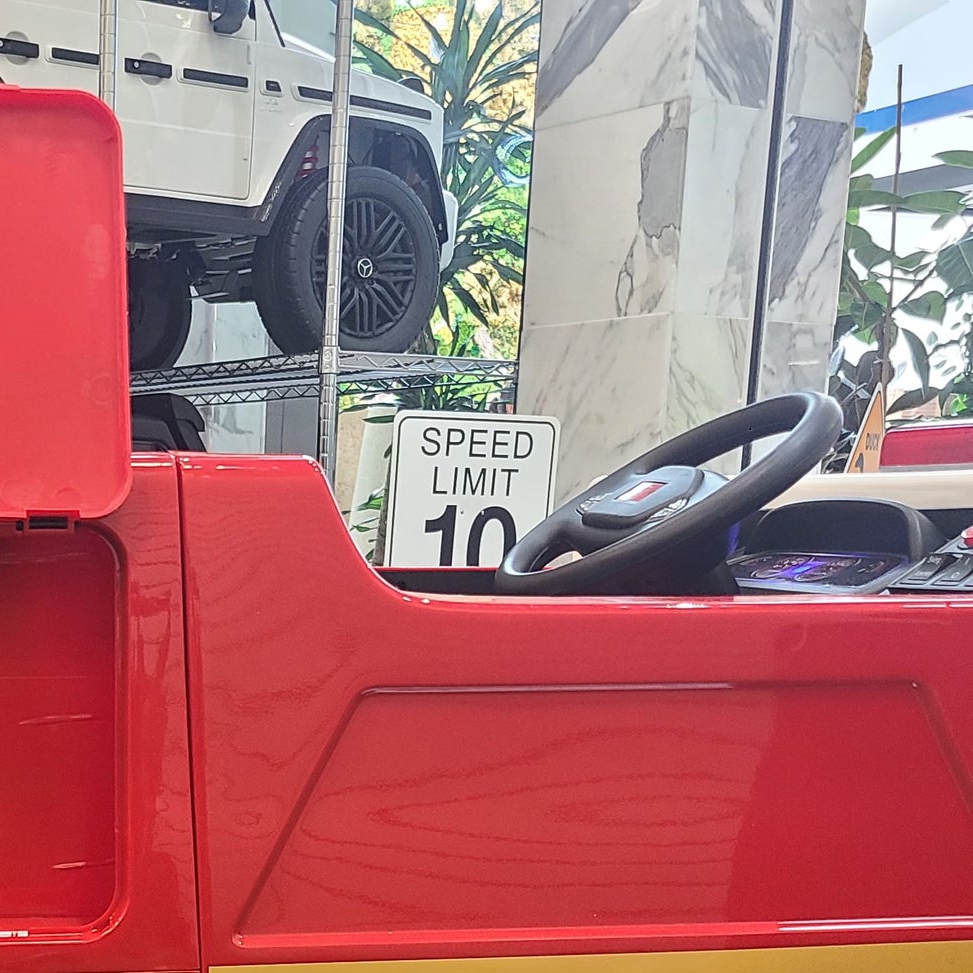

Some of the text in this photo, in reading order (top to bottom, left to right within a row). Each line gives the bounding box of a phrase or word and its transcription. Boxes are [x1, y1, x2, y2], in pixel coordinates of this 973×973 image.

[421, 427, 534, 459] SPEED
[432, 466, 520, 497] LIMIT
[424, 505, 518, 567] 10
